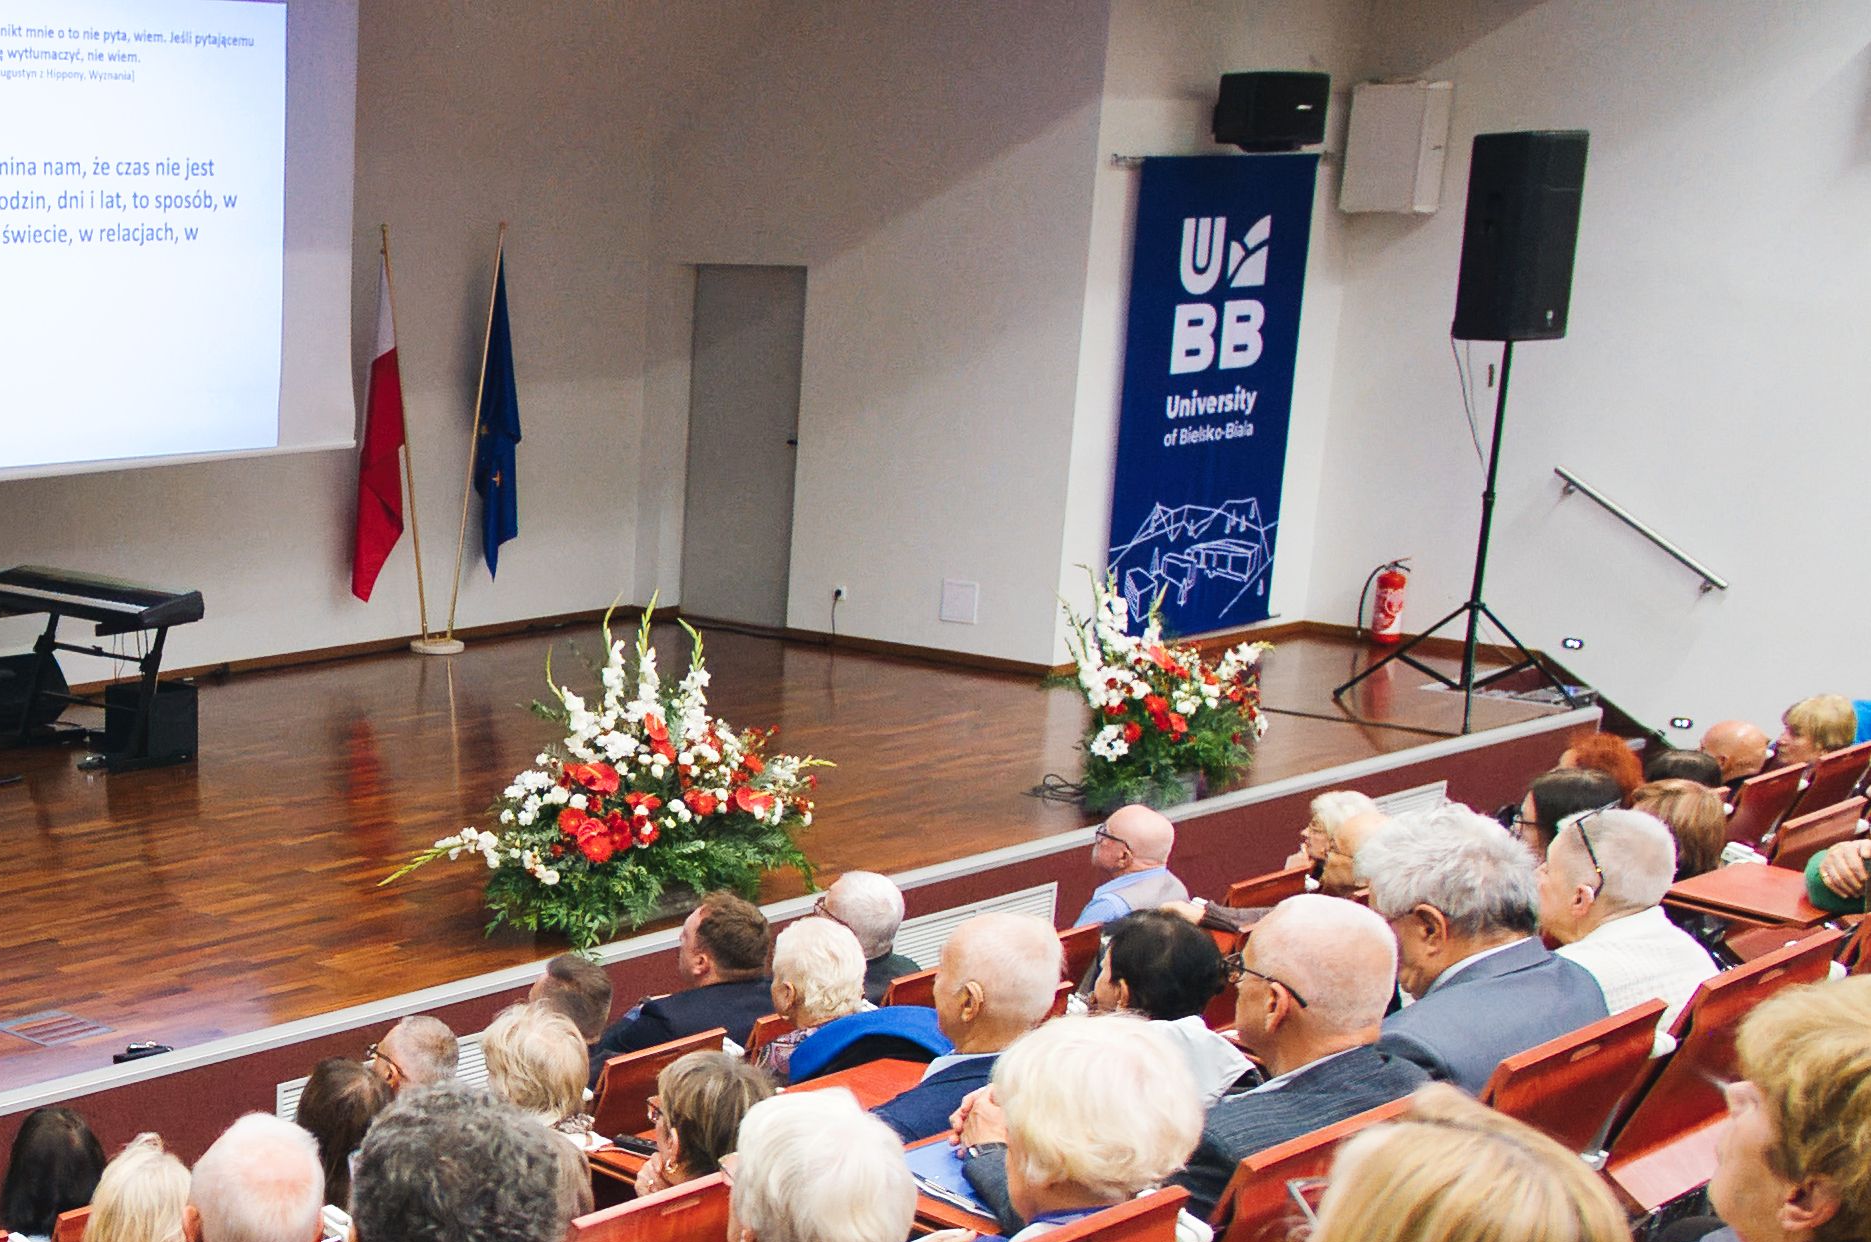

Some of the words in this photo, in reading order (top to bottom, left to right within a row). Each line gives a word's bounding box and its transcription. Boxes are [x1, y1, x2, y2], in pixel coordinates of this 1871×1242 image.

[0, 23, 22, 38] nikt
[26, 25, 54, 39] mnie
[57, 29, 65, 40] o
[68, 27, 80, 40] to
[83, 27, 100, 41] nie
[103, 29, 130, 44] pyta,
[133, 29, 167, 43] wiem.
[170, 30, 192, 44] Jeśli
[194, 32, 255, 48] pytającemu
[7, 46, 84, 64] wytłumaczyć,
[88, 49, 104, 62] nie
[107, 50, 141, 63] wiem.
[43, 160, 87, 180] nam,
[92, 156, 110, 176] że
[115, 160, 150, 177] czas
[155, 157, 181, 177] nie
[184, 157, 215, 181] jest
[57, 189, 84, 210] dni
[89, 189, 95, 210] i
[100, 189, 127, 213] lat,
[132, 191, 149, 210] to
[154, 188, 218, 213] sposób,
[222, 193, 238, 209] w
[2, 223, 73, 247] świecie,
[78, 228, 94, 244] w
[99, 221, 179, 247] relacjach,
[183, 225, 199, 241] w
[1166, 384, 1258, 419] University
[1163, 427, 1179, 448] of
